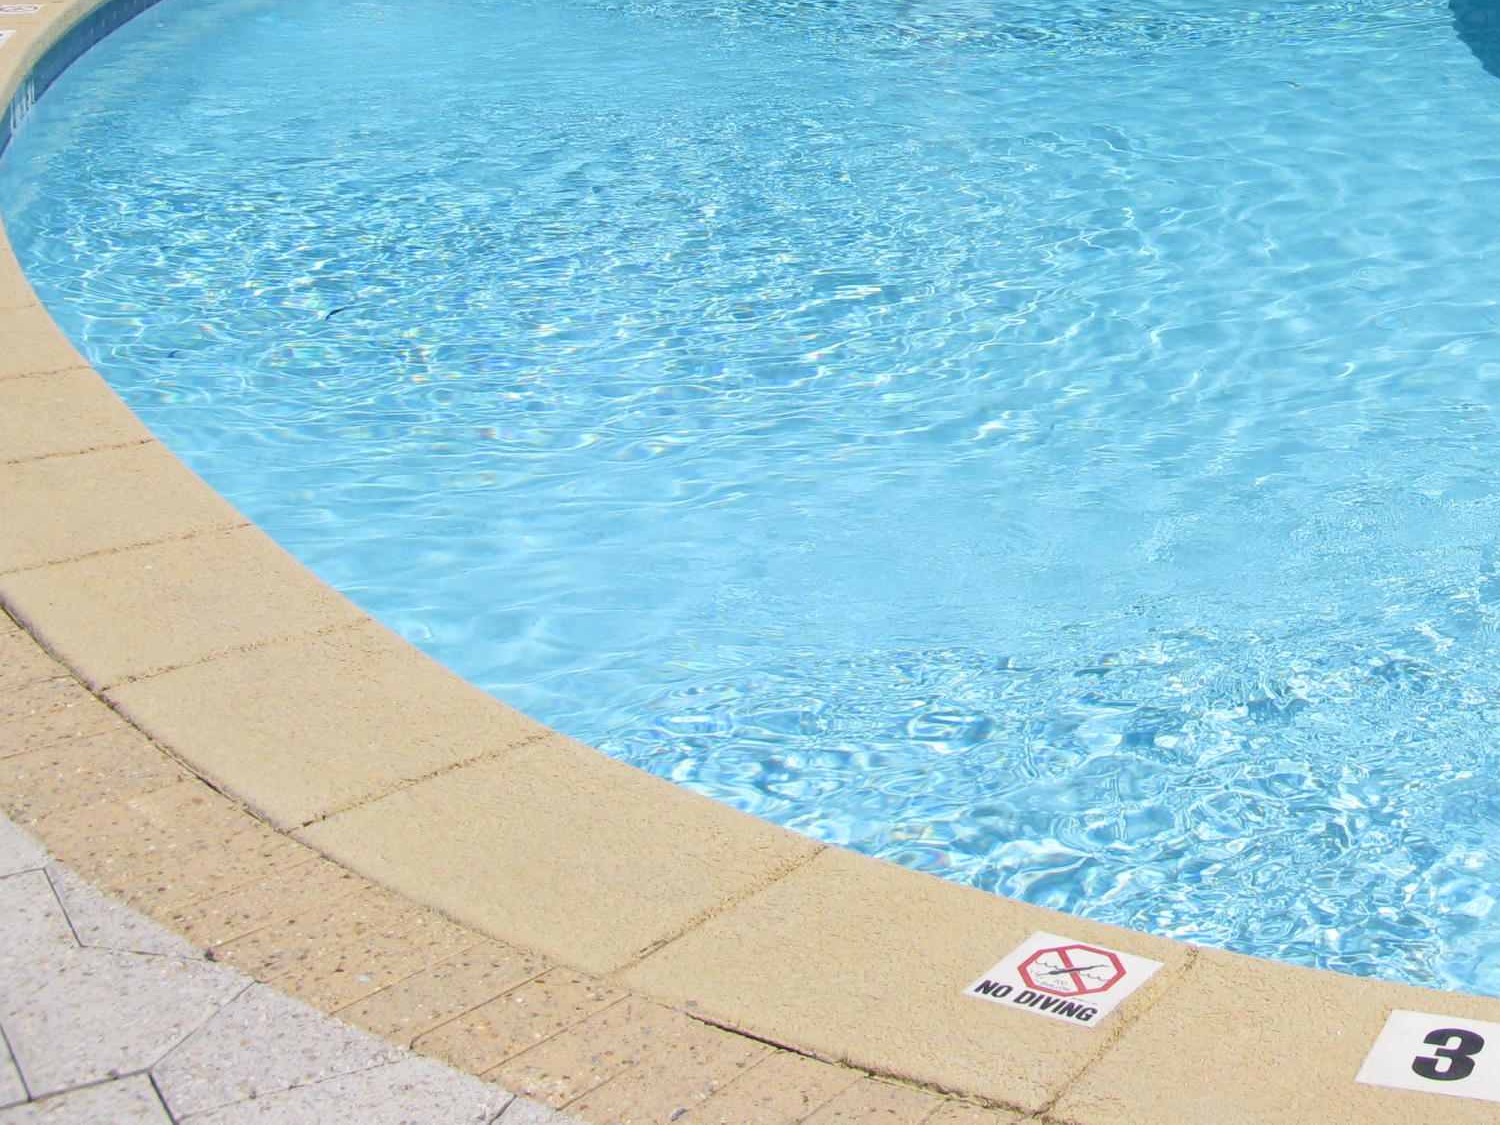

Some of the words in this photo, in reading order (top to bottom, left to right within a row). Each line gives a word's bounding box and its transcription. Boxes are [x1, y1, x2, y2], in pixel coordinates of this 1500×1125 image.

[974, 979, 1013, 998] NO
[1014, 989, 1099, 1022] DIVING
[1411, 1027, 1486, 1082] 3
